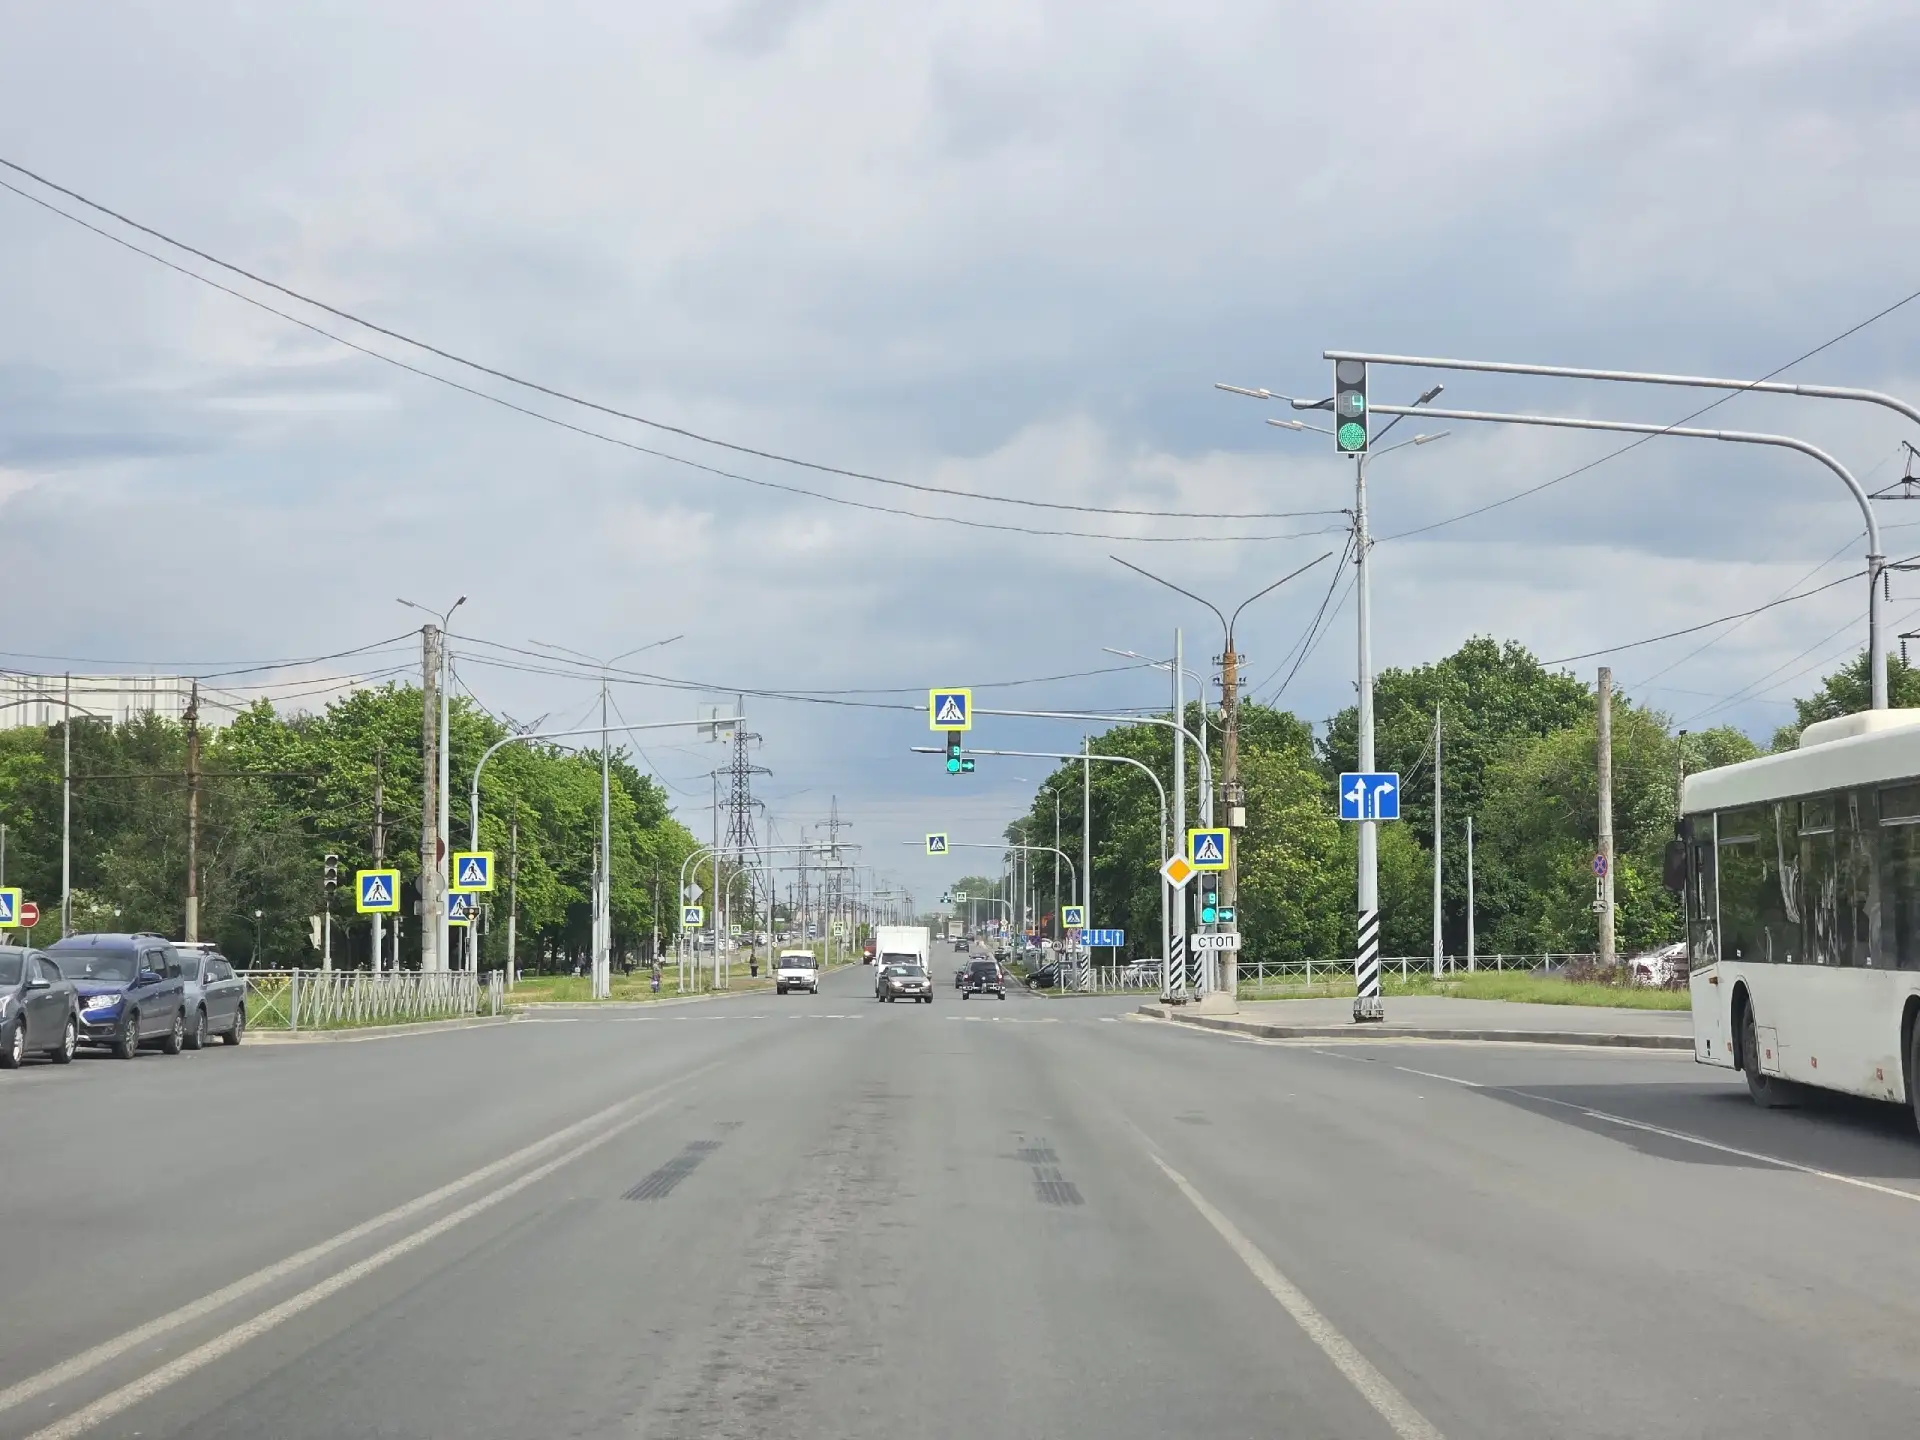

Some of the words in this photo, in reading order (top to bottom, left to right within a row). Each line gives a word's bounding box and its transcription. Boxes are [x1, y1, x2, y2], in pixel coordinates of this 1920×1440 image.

[1352, 394, 1364, 412] 4
[953, 746, 960, 756] 9
[1208, 893, 1216, 905] 9
[1198, 936, 1234, 948] СТОП
